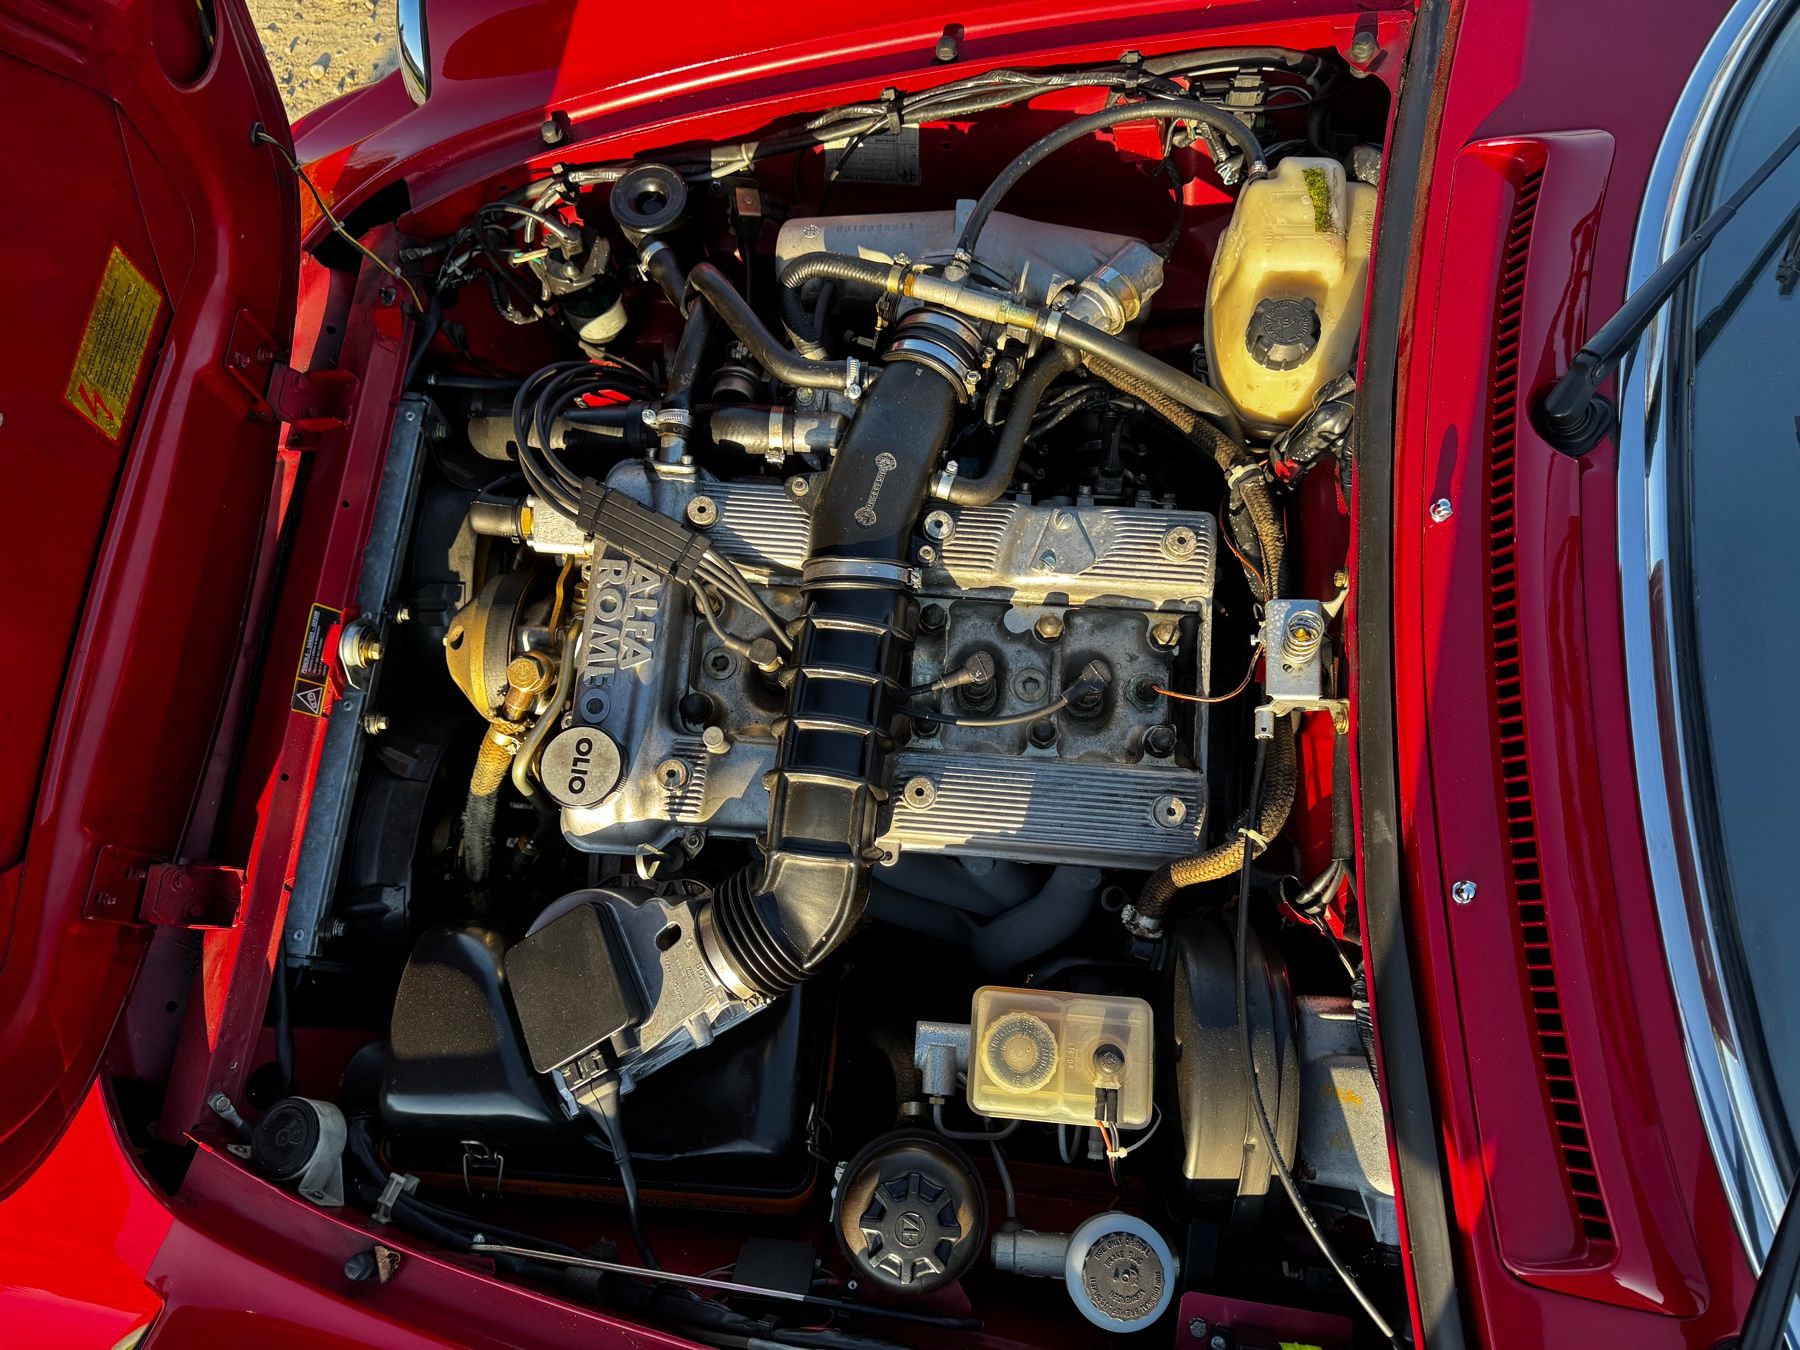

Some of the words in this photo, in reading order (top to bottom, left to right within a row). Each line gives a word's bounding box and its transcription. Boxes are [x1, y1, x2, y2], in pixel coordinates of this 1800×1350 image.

[618, 562, 661, 670] ALFA
[580, 559, 629, 724] ROMEO
[568, 737, 593, 794] OLIO
[695, 962, 714, 996] BOSCH
[1094, 1245, 1107, 1260] USE
[1106, 1237, 1122, 1250] ONLY
[1104, 1250, 1124, 1268] BRAKE
